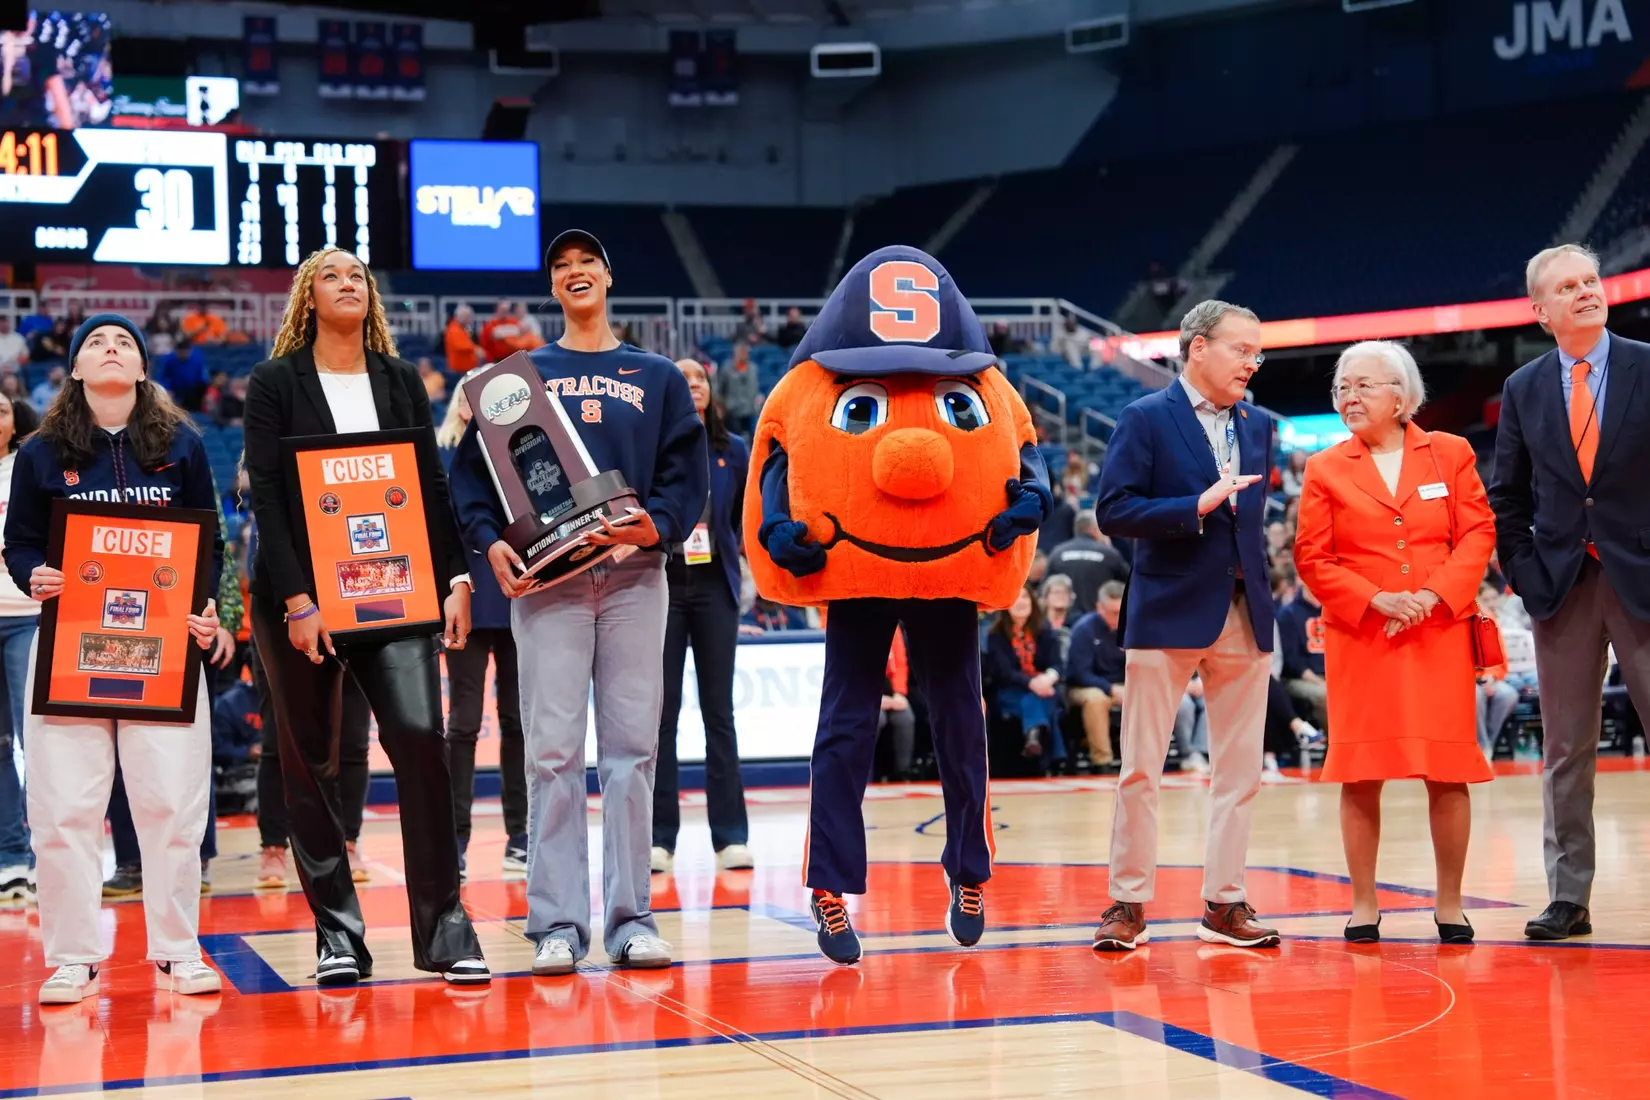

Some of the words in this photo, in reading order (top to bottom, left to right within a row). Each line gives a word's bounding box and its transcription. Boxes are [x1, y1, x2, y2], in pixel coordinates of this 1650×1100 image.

[1492, 0, 1634, 61] JMA
[135, 168, 194, 231] 30
[869, 261, 940, 342] S
[487, 388, 529, 420] NCAA
[545, 375, 644, 413] YRACUSE
[581, 399, 602, 423] S
[514, 437, 542, 456] DIVISION
[64, 469, 79, 486] S
[325, 456, 389, 482] 'CUSE
[68, 486, 172, 508] ACUSE
[97, 528, 165, 556] 'CUSE
[526, 531, 560, 558] NATIONAL
